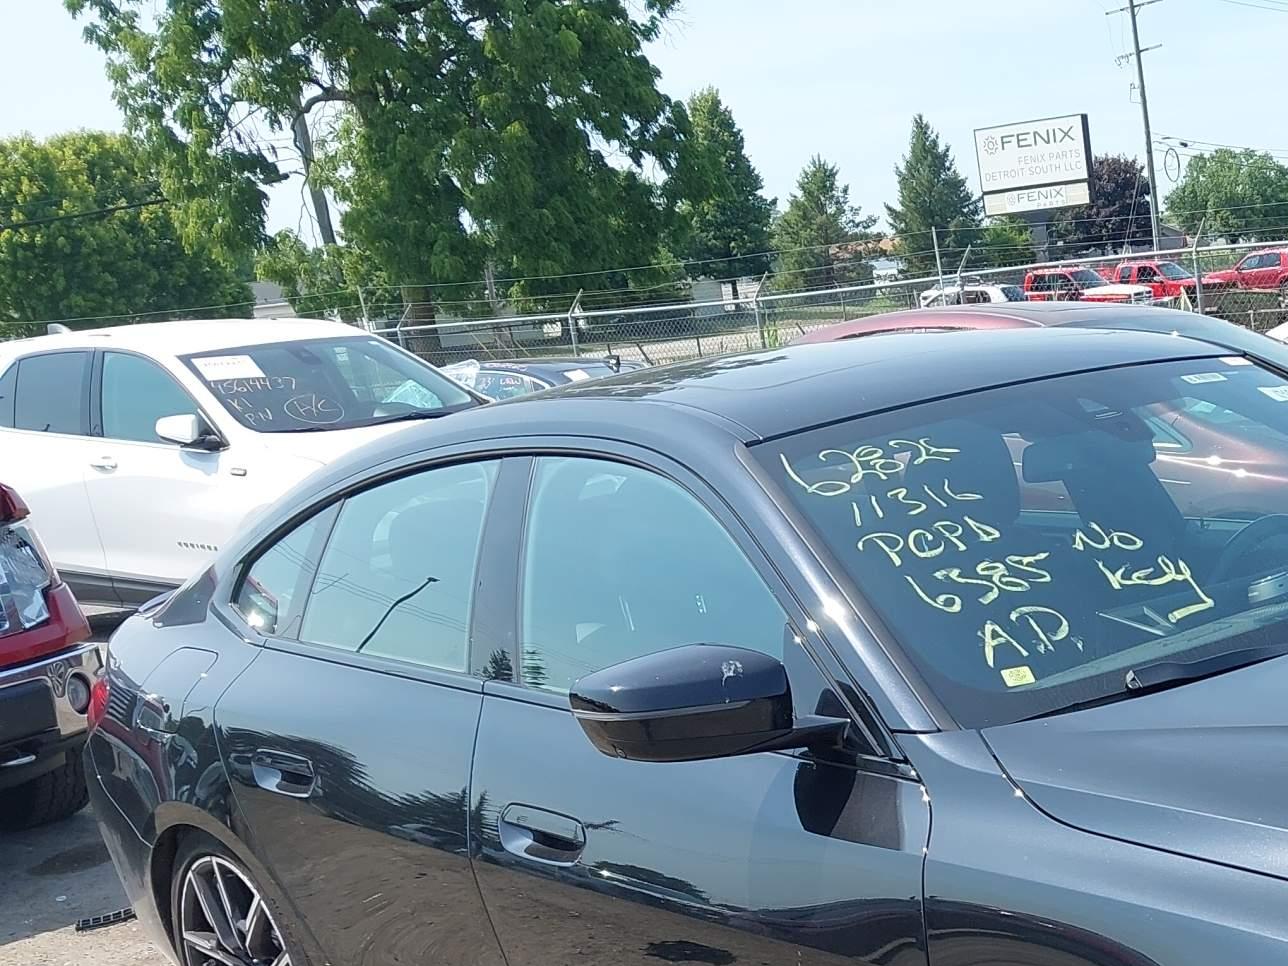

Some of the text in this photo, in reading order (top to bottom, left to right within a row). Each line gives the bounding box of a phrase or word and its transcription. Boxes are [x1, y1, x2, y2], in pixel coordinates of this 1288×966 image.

[1000, 125, 1075, 151] FENIX
[1017, 149, 1081, 166] FENIX PARTS
[984, 160, 1083, 183] DETROIT SOUTH LLC
[1017, 187, 1065, 204] FENIX
